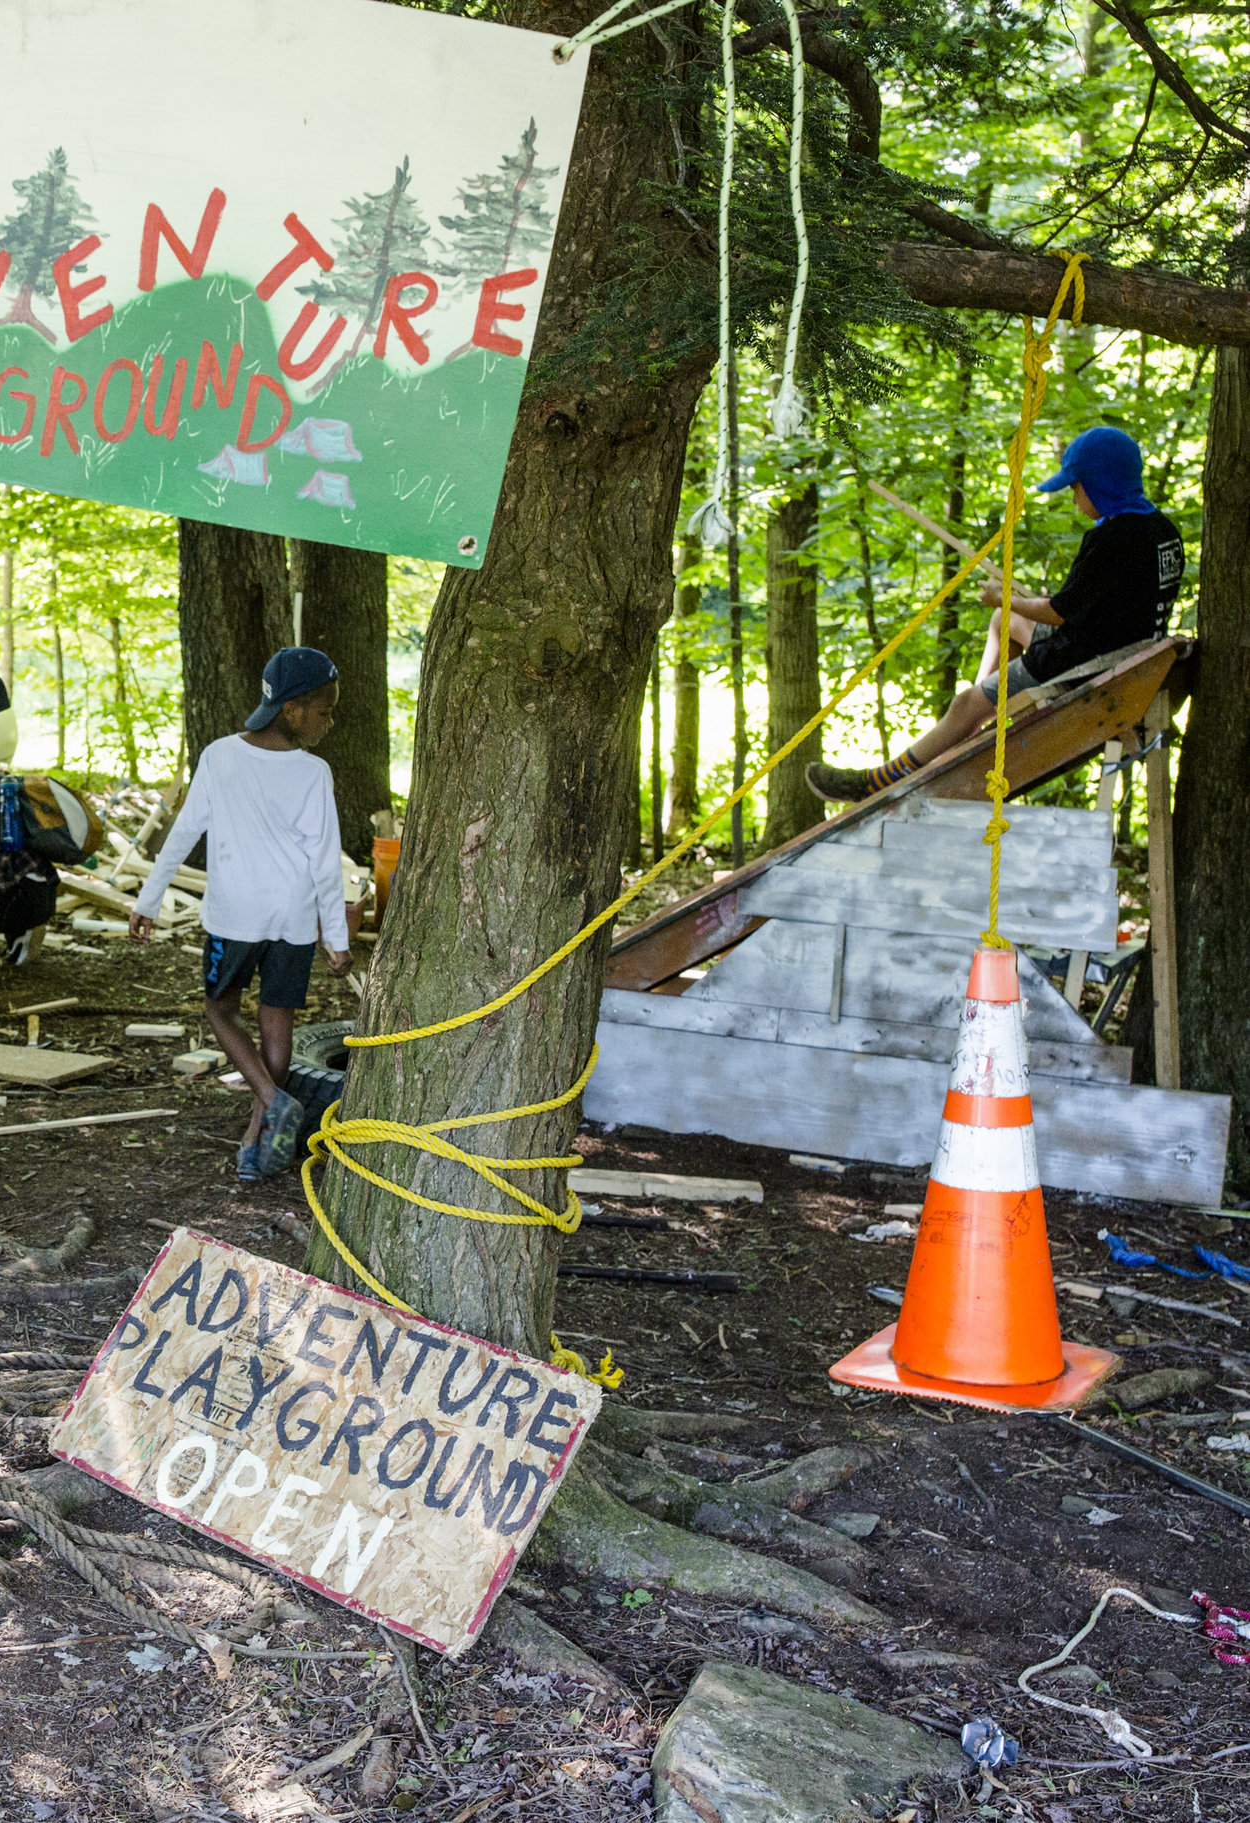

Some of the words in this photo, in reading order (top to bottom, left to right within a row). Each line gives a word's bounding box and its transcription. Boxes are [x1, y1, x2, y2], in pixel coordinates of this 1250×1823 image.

[96, 1315, 549, 1537] PLAYGROUND
[151, 1258, 579, 1455] ADVENTURE
[157, 1433, 394, 1595] OPEN
